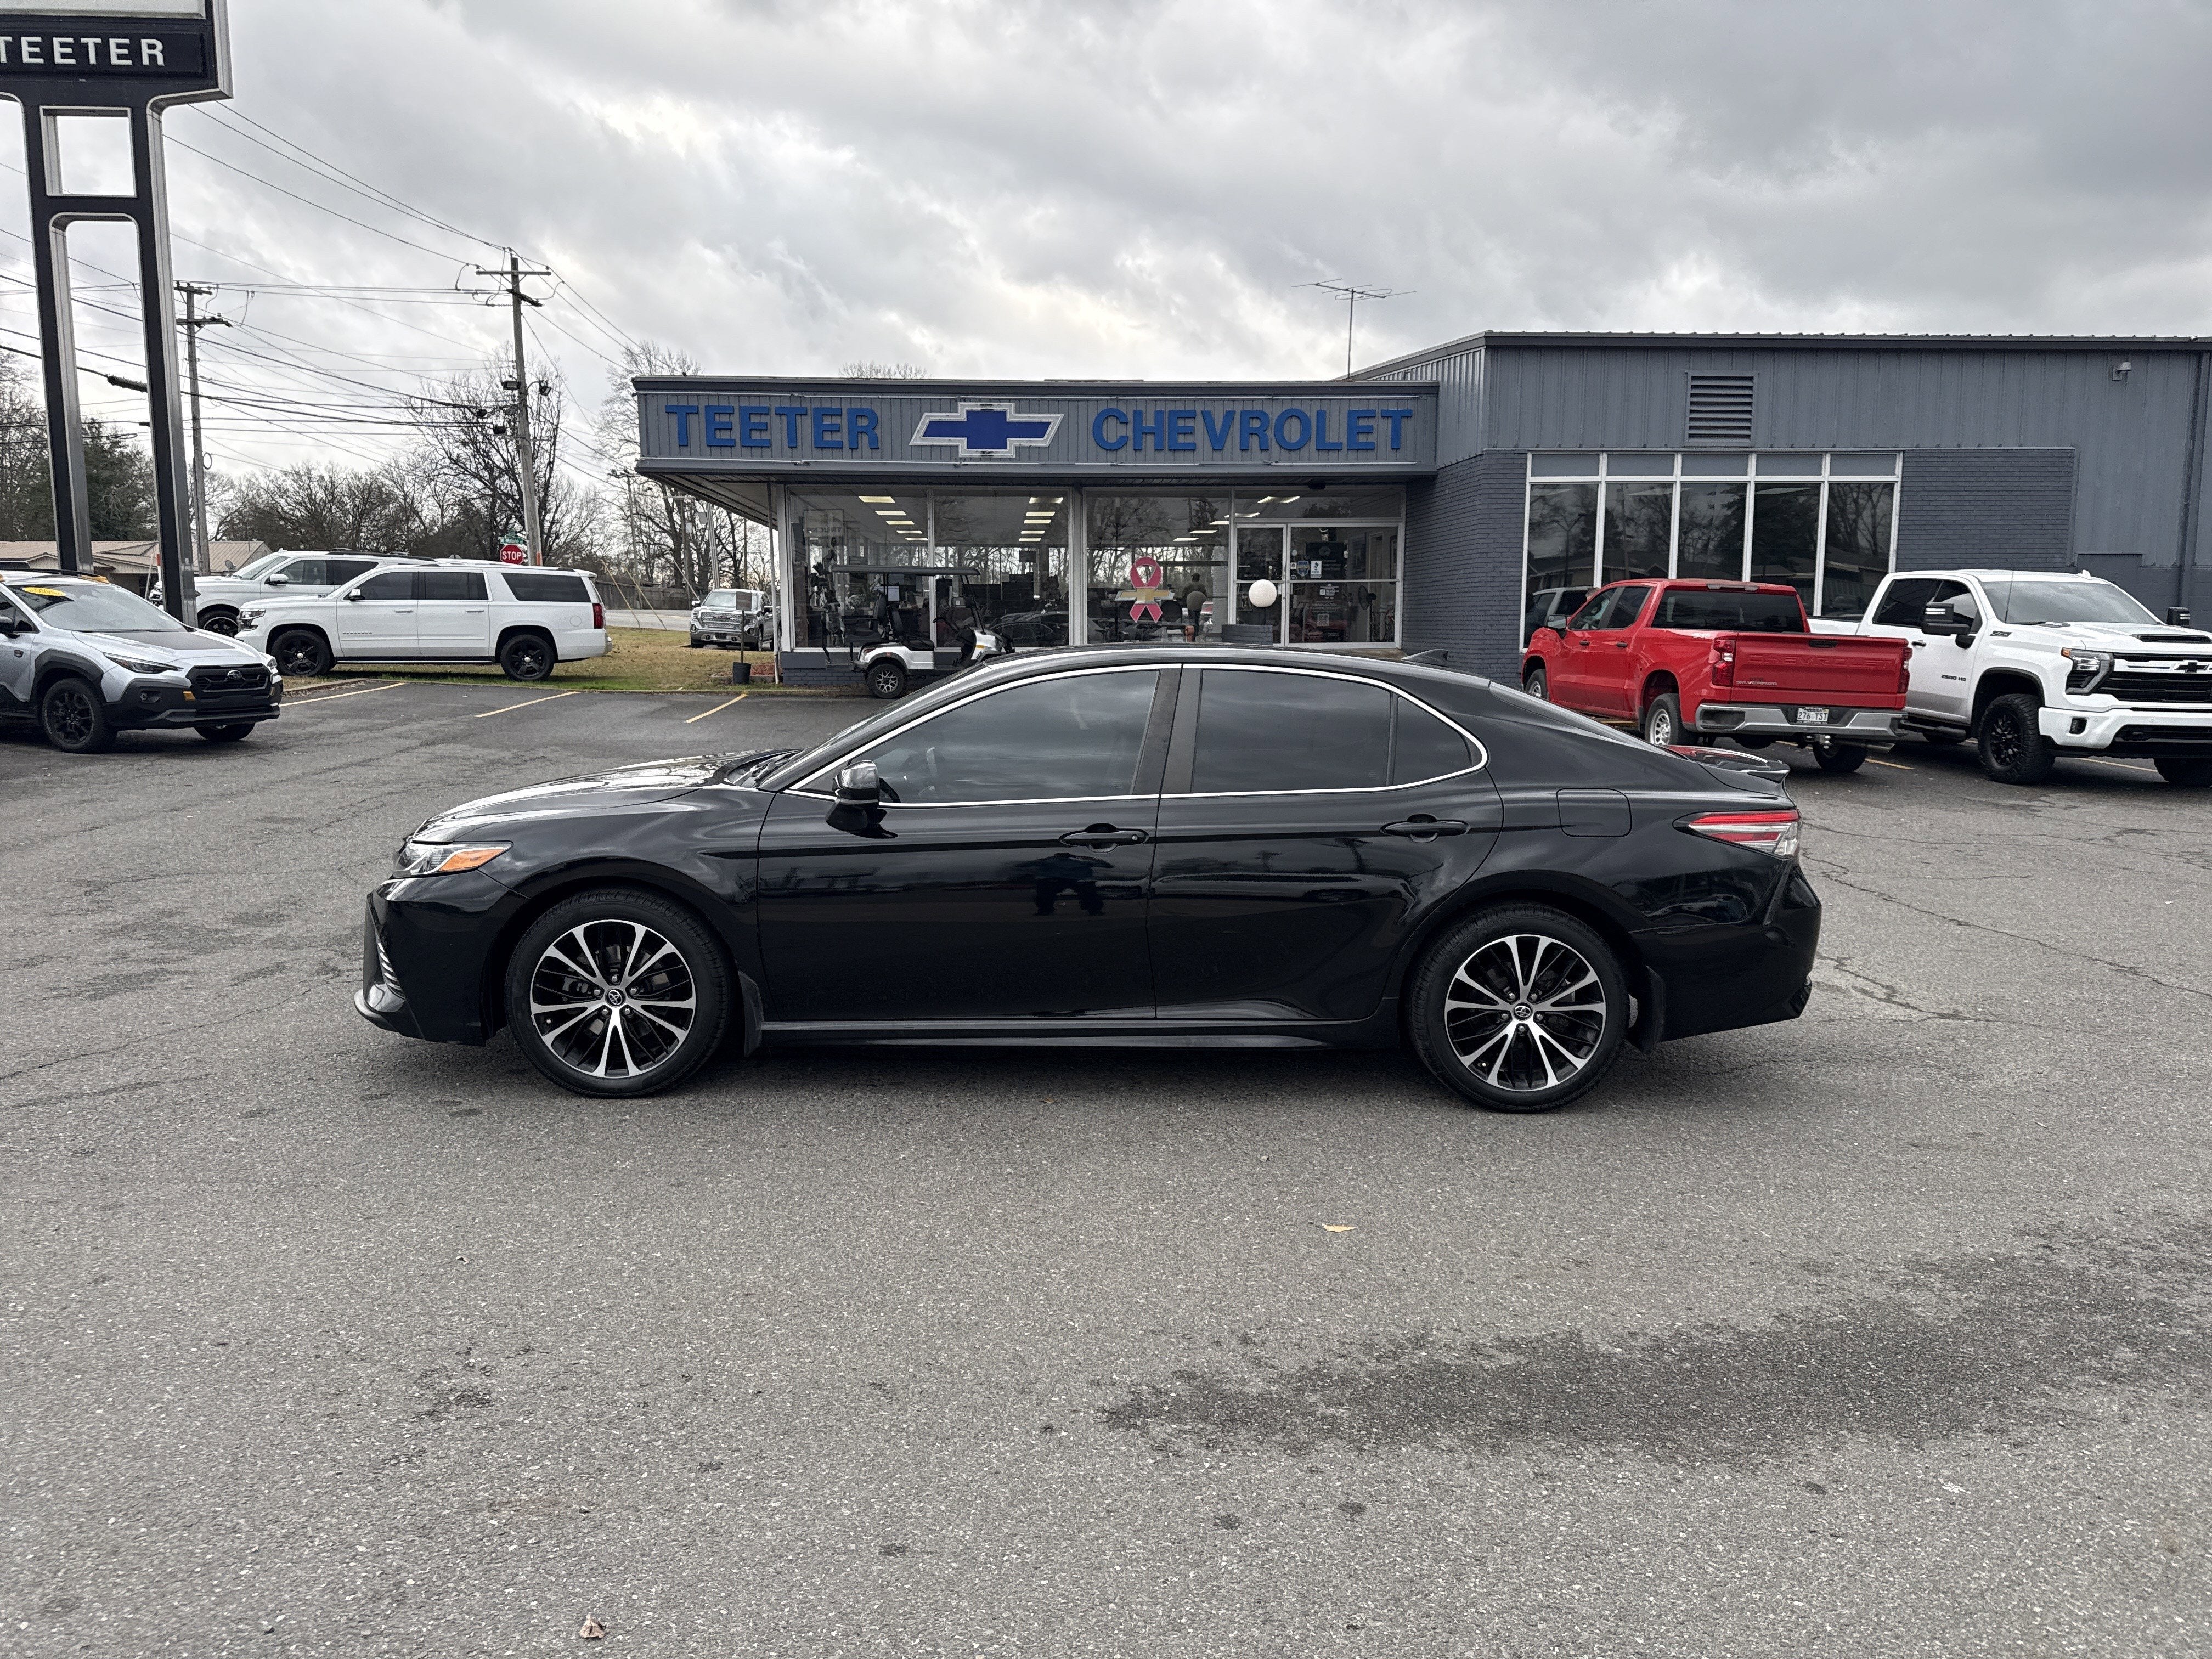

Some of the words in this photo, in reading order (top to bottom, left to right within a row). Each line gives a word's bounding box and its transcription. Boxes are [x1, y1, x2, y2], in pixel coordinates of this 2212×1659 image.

[0, 36, 165, 66] TEETER
[665, 405, 879, 449] TEETER
[1092, 408, 1413, 451] CHEVROLET
[502, 551, 522, 560] STOP
[1798, 712, 1810, 720] 276
